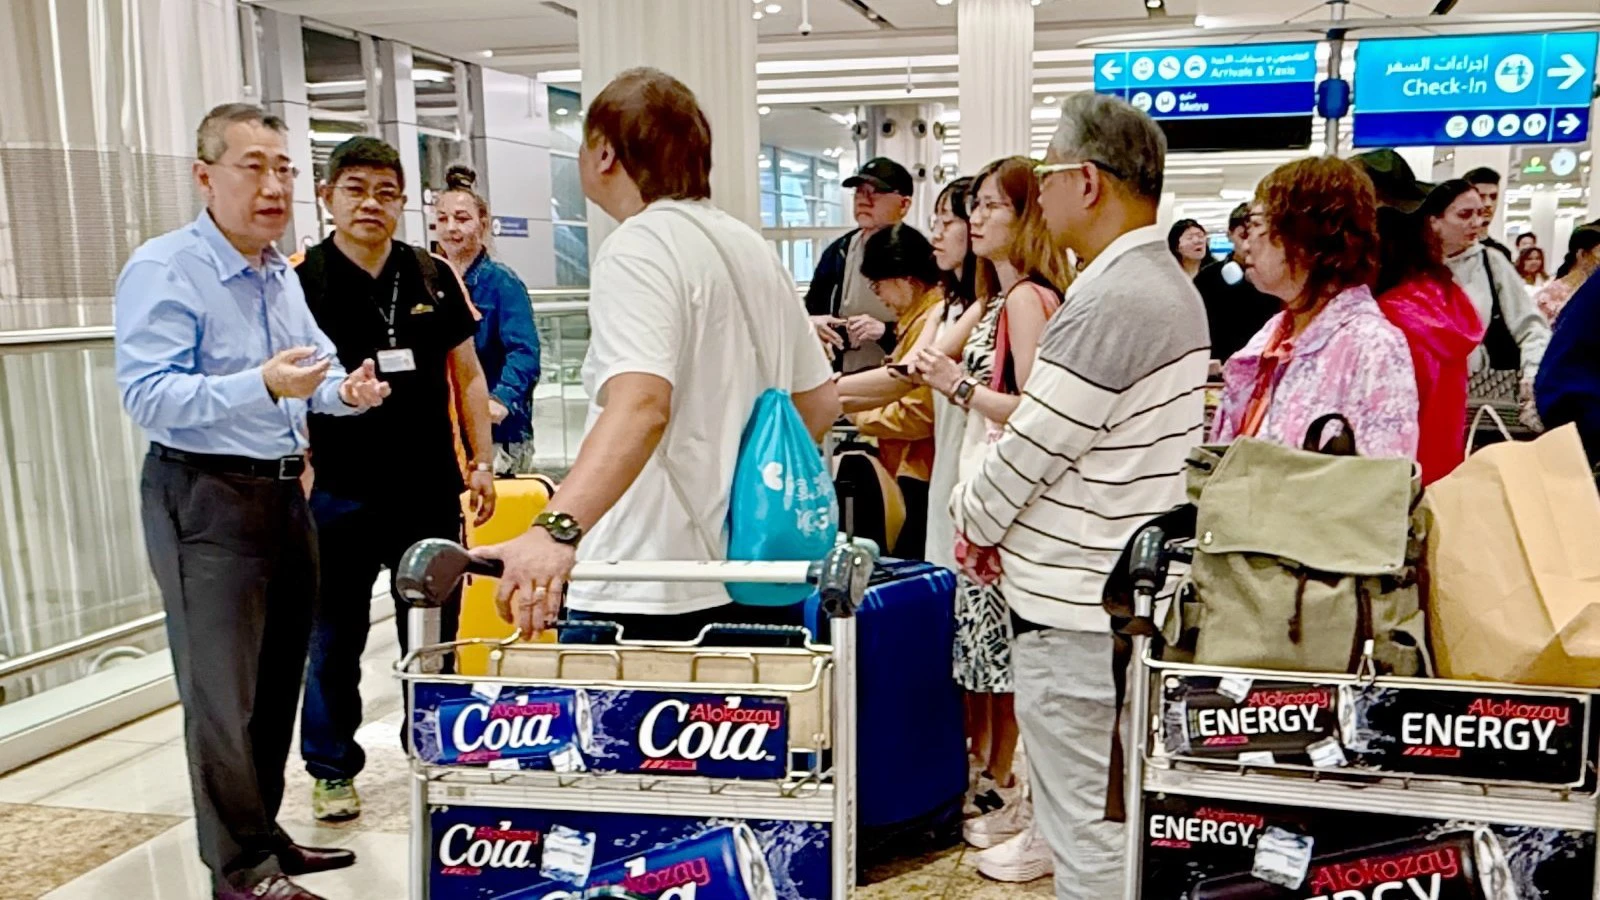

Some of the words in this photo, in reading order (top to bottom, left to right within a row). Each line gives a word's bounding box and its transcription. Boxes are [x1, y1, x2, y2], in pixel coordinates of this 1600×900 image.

[1402, 77, 1488, 97] Check-In
[452, 695, 553, 753] Cola
[638, 696, 771, 761] Cola
[690, 703, 780, 729] Alokozay
[1199, 703, 1320, 737] ENERGY
[1468, 698, 1570, 727] Alokozay
[1402, 712, 1557, 752] ENERGY
[439, 820, 532, 868] Cola
[1150, 814, 1256, 847] ENERGY
[1310, 848, 1458, 895] Alokozay
